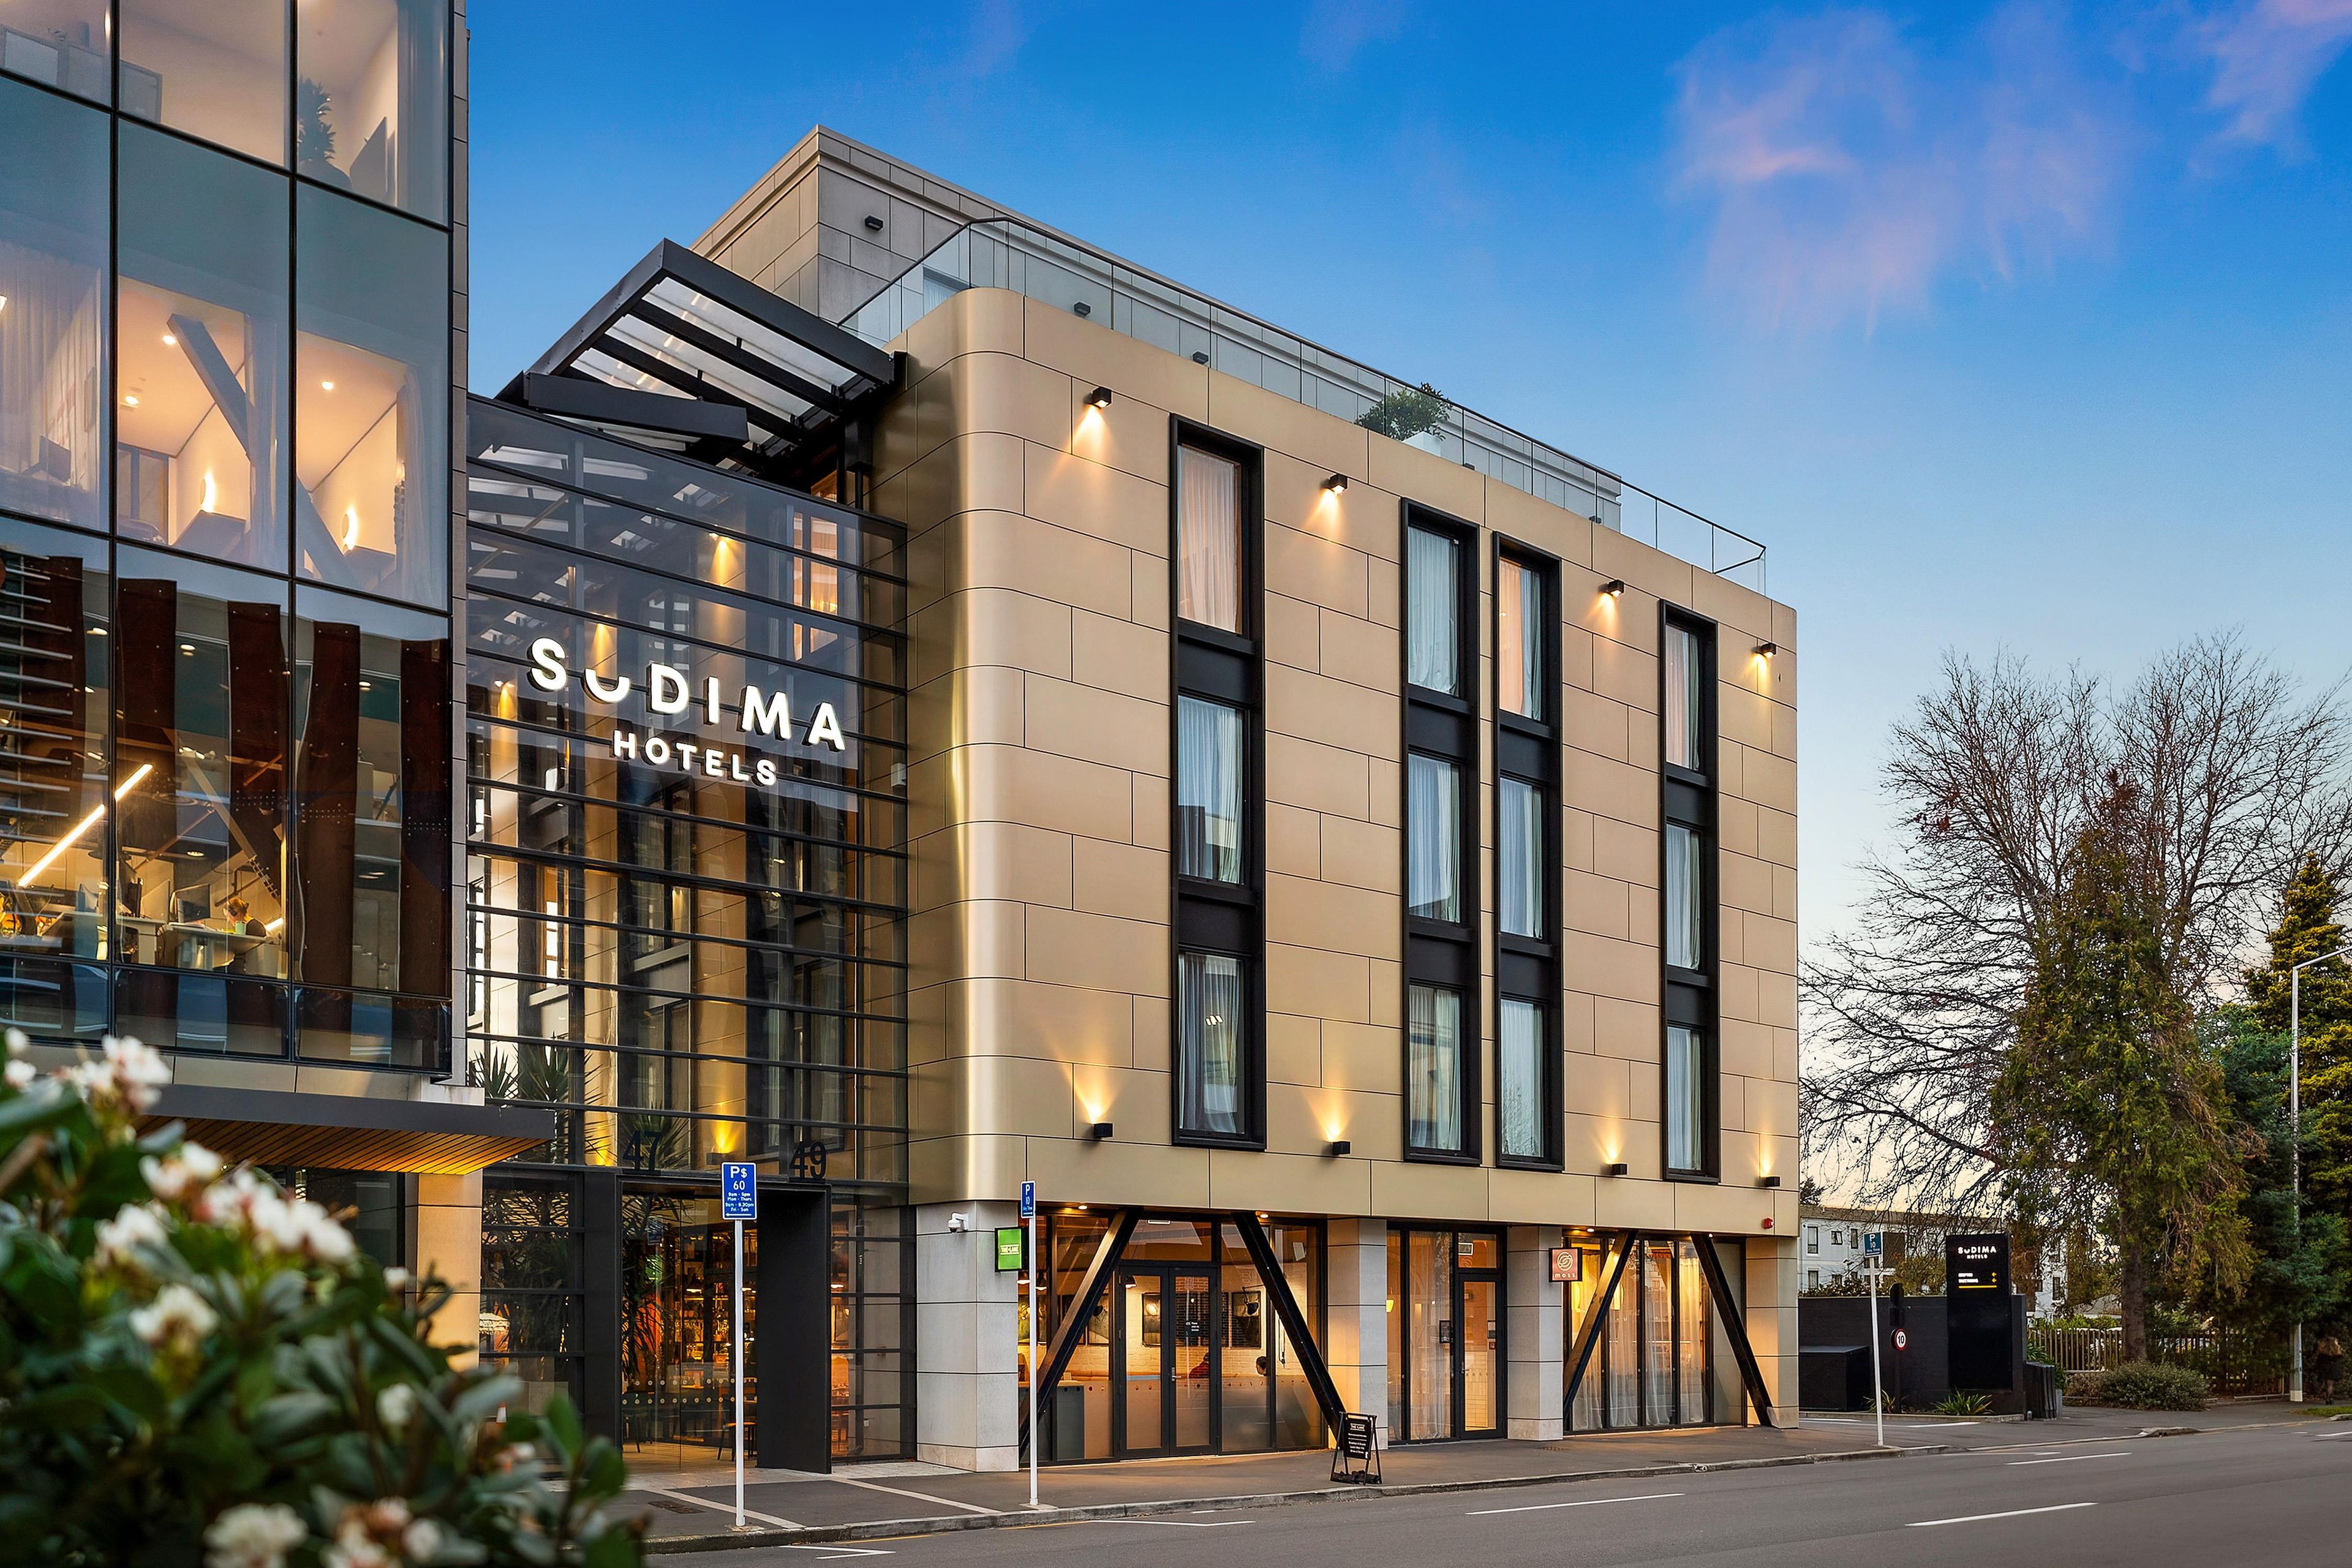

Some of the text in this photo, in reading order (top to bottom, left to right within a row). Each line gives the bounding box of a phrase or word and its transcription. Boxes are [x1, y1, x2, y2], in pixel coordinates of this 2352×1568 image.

[528, 637, 847, 752] SUDIMA
[612, 729, 778, 786] HOTELS
[623, 1130, 662, 1170] 47
[789, 1141, 827, 1179] 49
[733, 1180, 745, 1190] 60
[1025, 1184, 1030, 1195] P
[1898, 1335, 1904, 1344] 10
